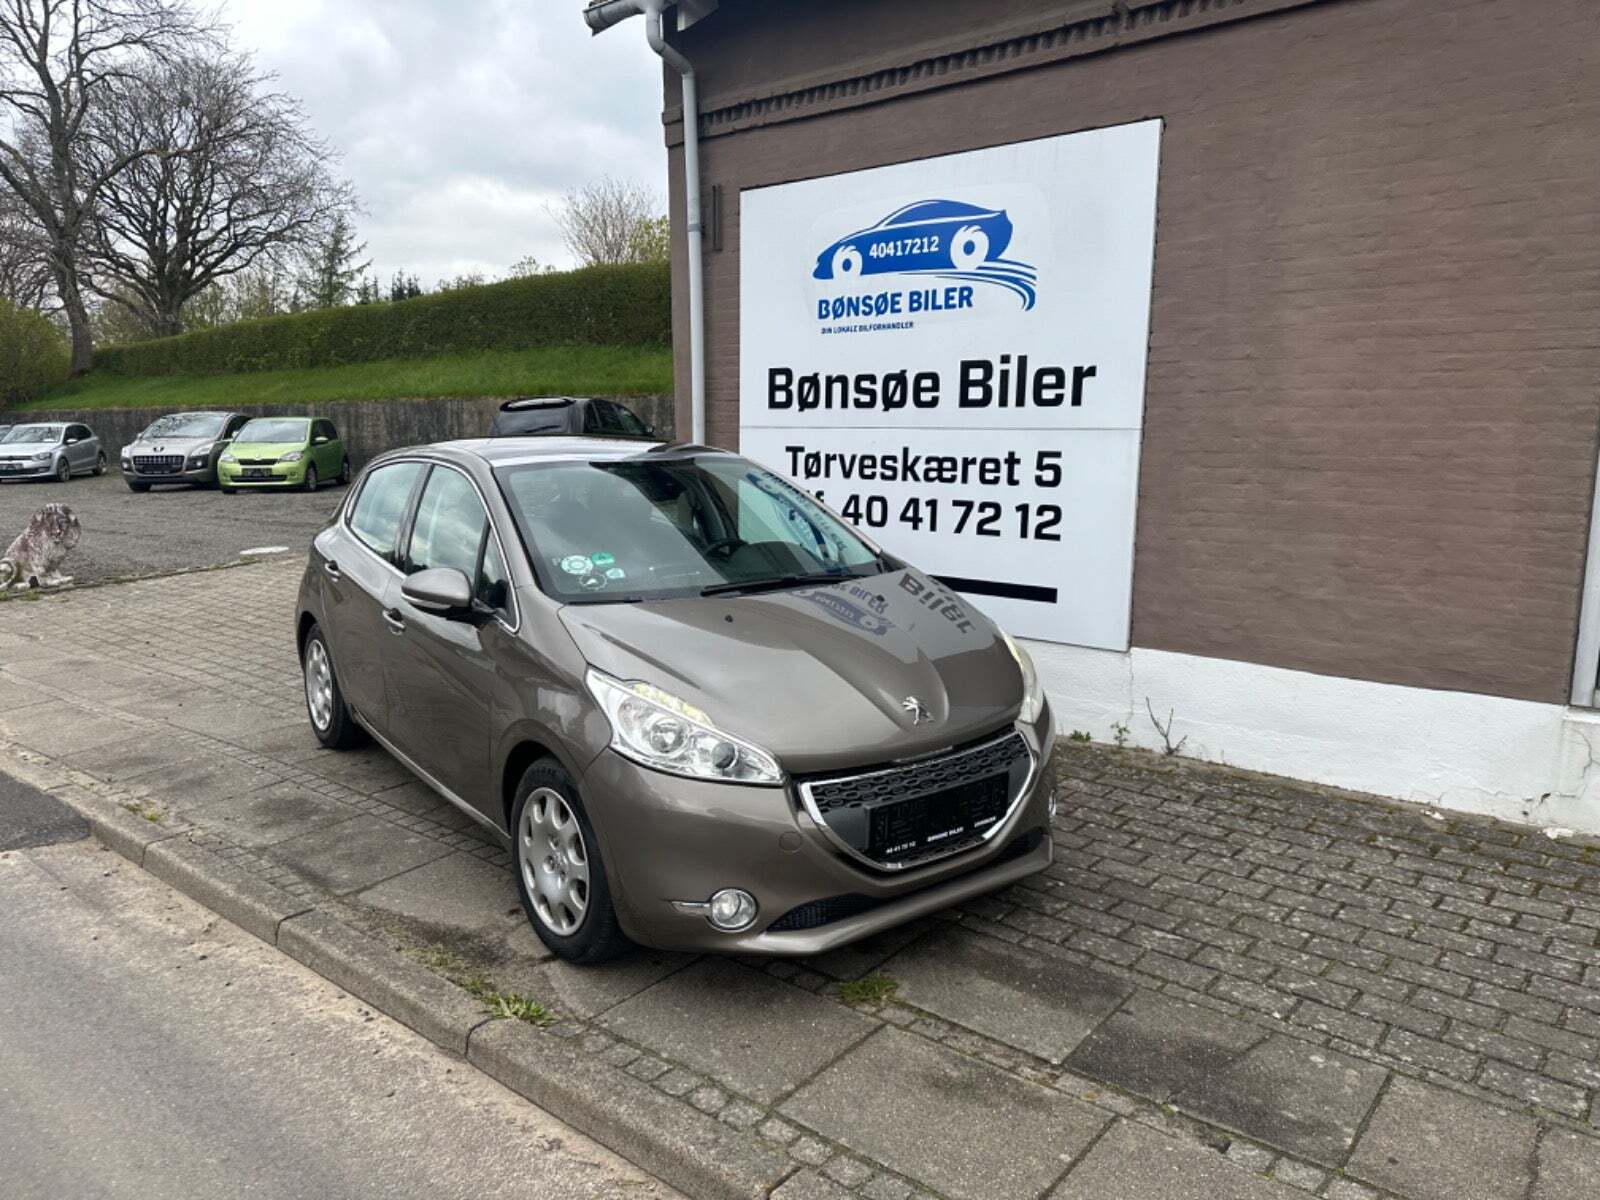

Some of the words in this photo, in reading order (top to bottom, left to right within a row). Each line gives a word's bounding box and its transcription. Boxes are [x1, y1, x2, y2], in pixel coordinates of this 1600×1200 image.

[869, 235, 939, 259] 40417212
[817, 291, 903, 321] BØNSØE
[908, 285, 974, 313] BILER
[767, 367, 941, 413] Bønsøe
[958, 354, 1097, 409] Biler
[785, 445, 1022, 487] Tørveskæret
[1034, 450, 1063, 488] 5
[841, 493, 889, 528] 40
[899, 497, 938, 533] 41
[951, 499, 1002, 538] 72
[1014, 502, 1063, 542] 12
